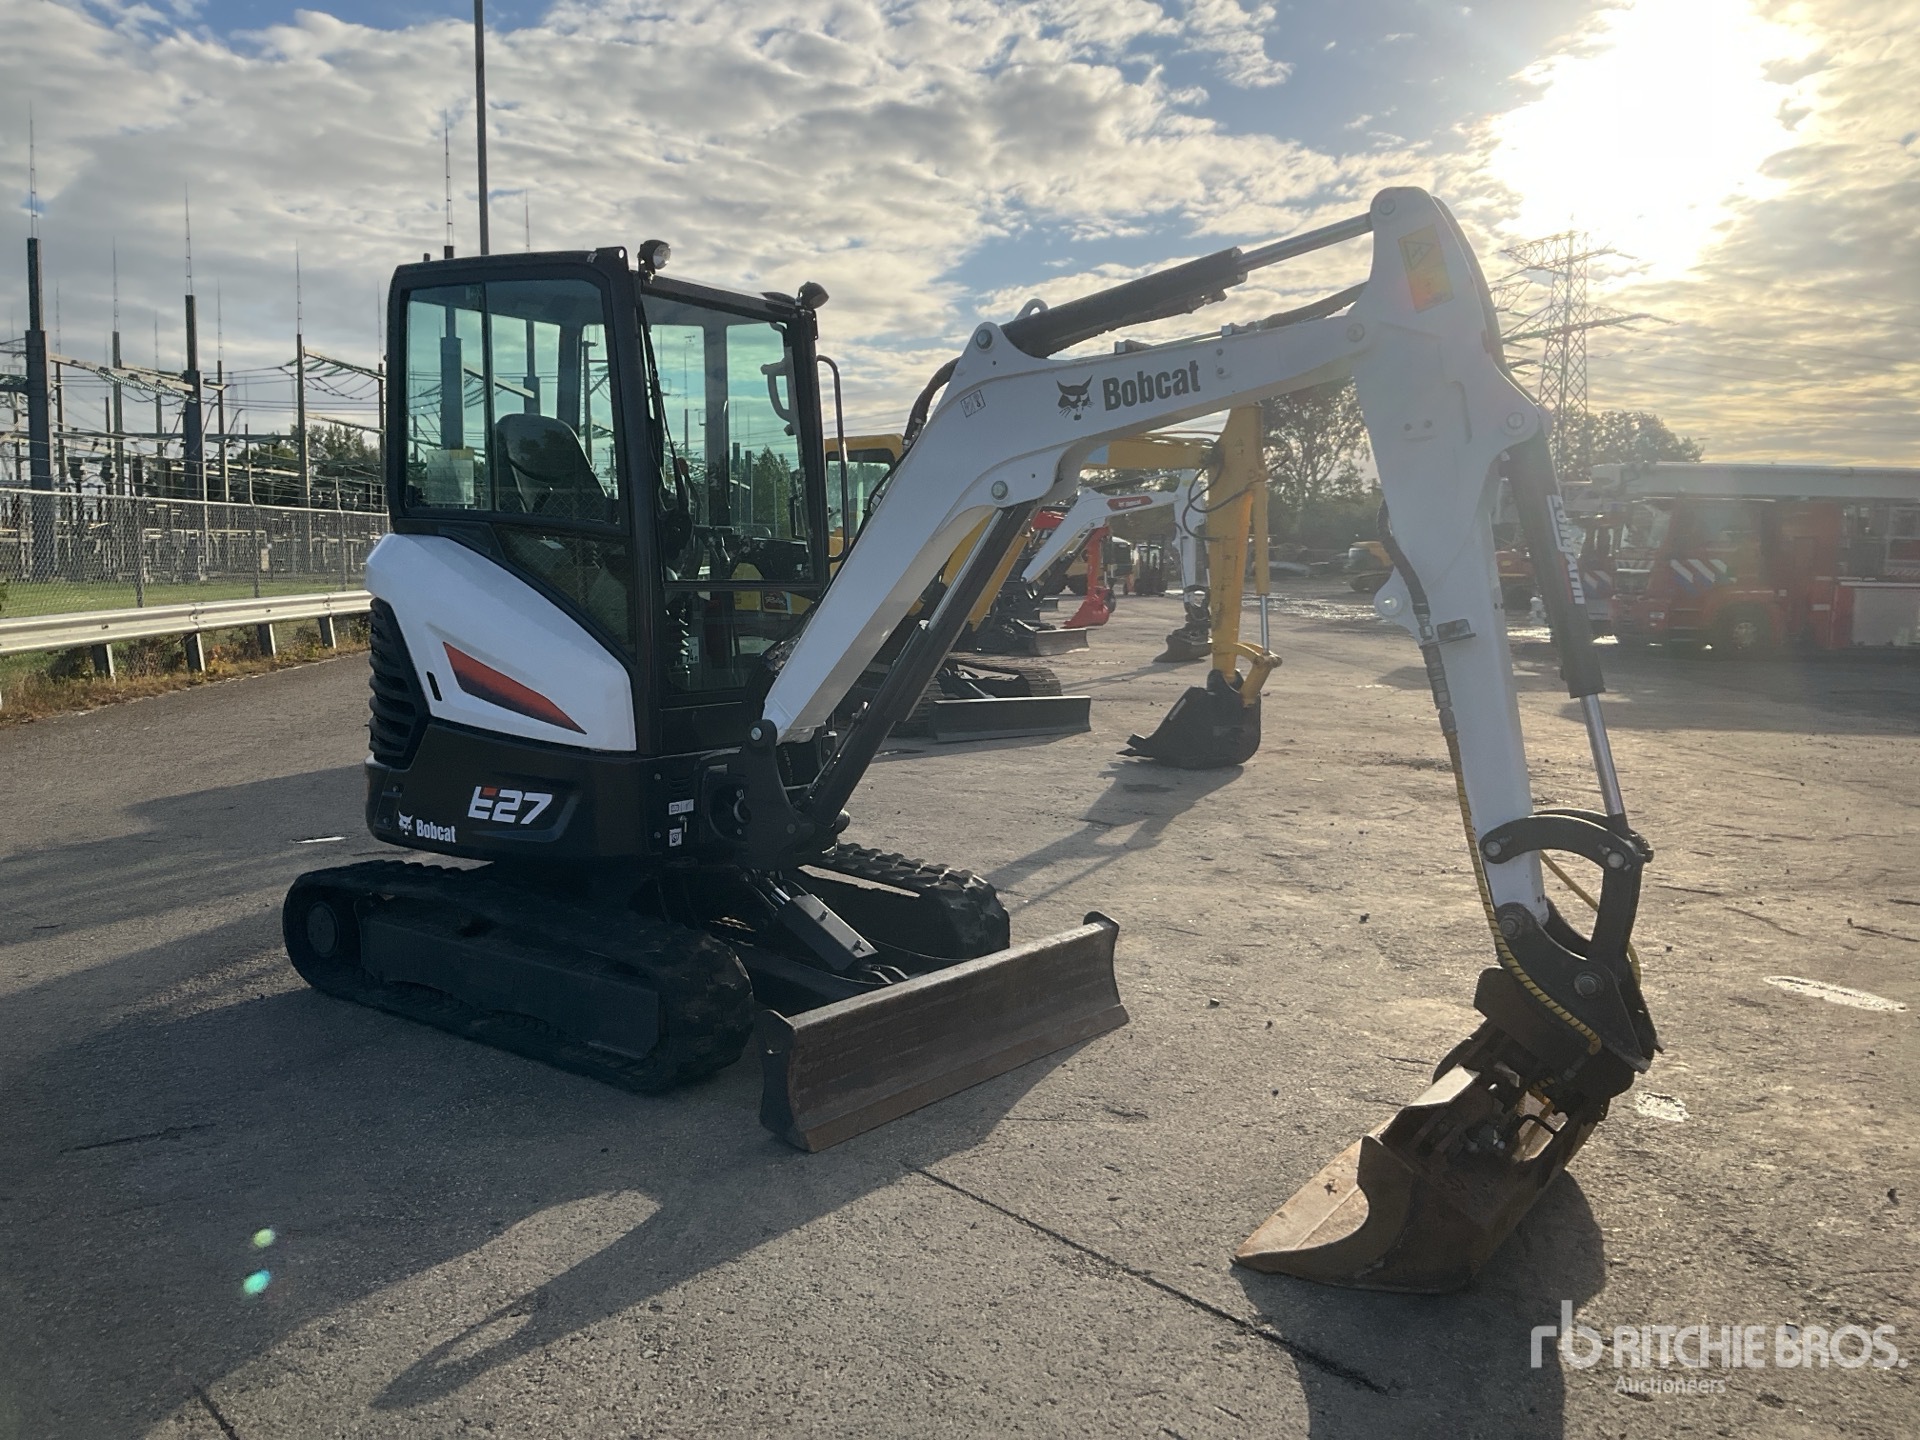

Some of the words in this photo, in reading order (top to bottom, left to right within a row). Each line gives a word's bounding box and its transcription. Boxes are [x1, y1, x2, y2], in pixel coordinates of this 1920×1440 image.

[1103, 360, 1201, 411] Bobcat
[467, 786, 553, 825] E27
[416, 819, 456, 843] Bobcat
